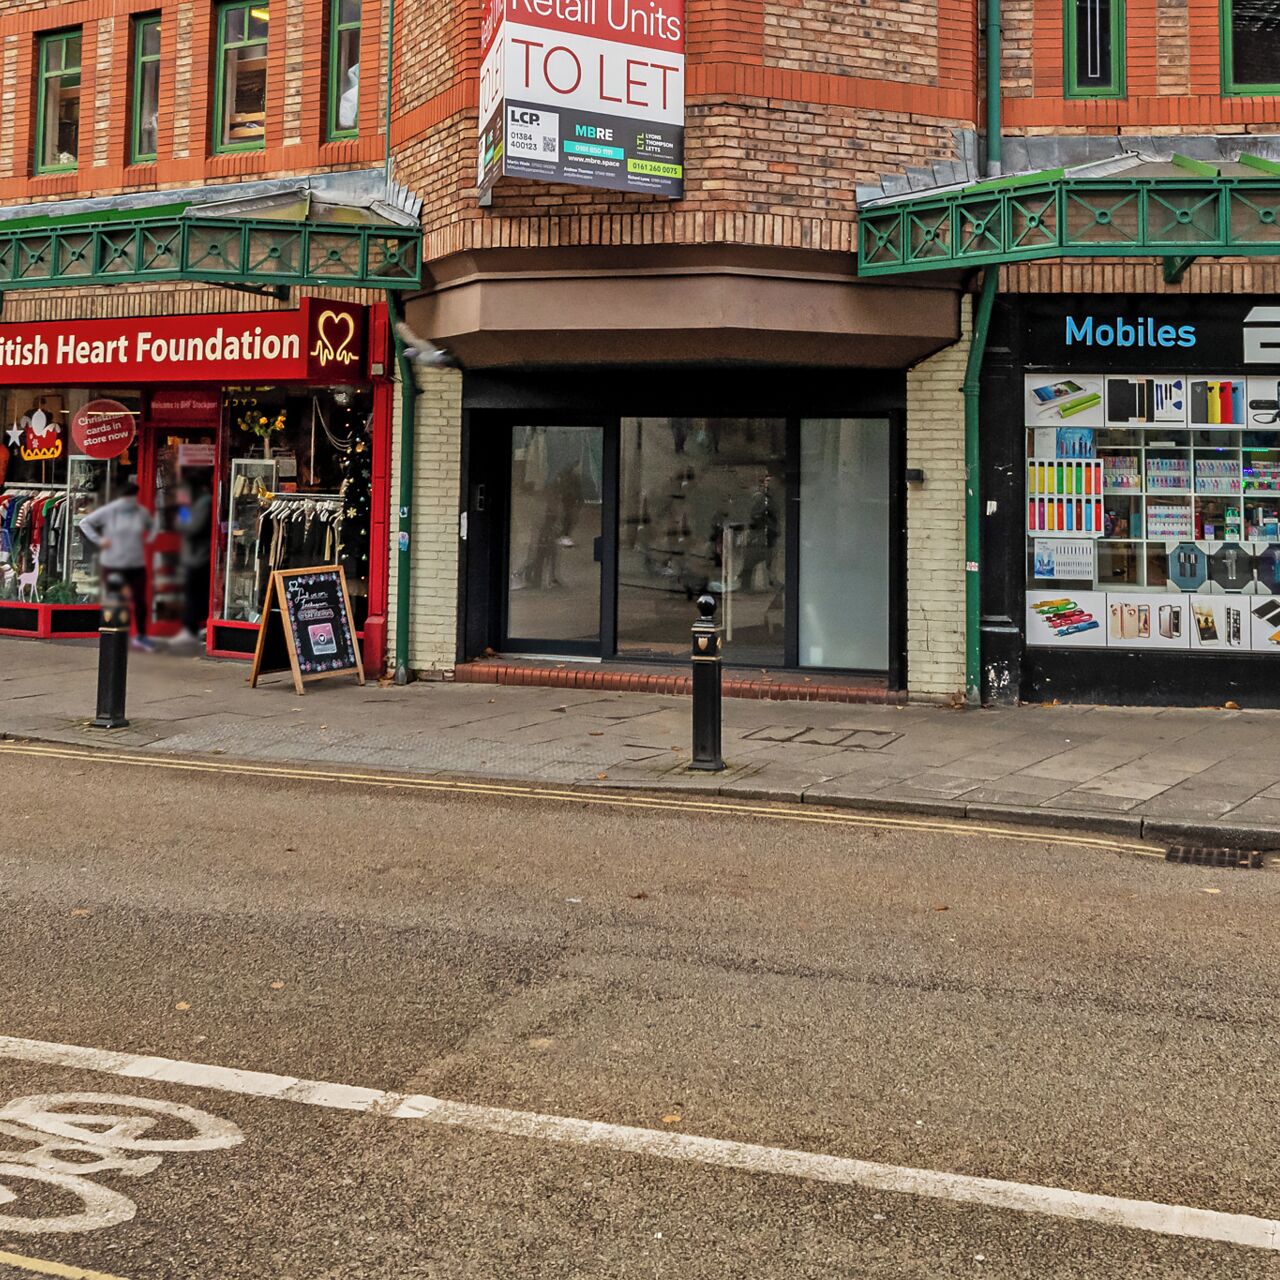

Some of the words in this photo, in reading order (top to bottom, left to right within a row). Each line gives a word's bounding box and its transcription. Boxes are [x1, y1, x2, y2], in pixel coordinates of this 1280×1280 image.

[511, 38, 582, 95] TO
[598, 53, 679, 110] LET
[511, 110, 540, 126] LCP.
[510, 131, 533, 141] 01384
[575, 124, 614, 141] MBRE
[645, 133, 662, 141] LYONS
[510, 140, 538, 151] 400123
[645, 139, 674, 149] THOMPSON
[567, 155, 620, 167] www.mbre.space
[632, 162, 648, 170] 0161
[1065, 316, 1196, 348] Mobiles
[56, 334, 129, 364] Heart
[136, 326, 300, 362] Foundation
[86, 424, 112, 436] cards
[112, 421, 122, 431] in
[83, 435, 108, 446] store
[108, 430, 130, 442] now
